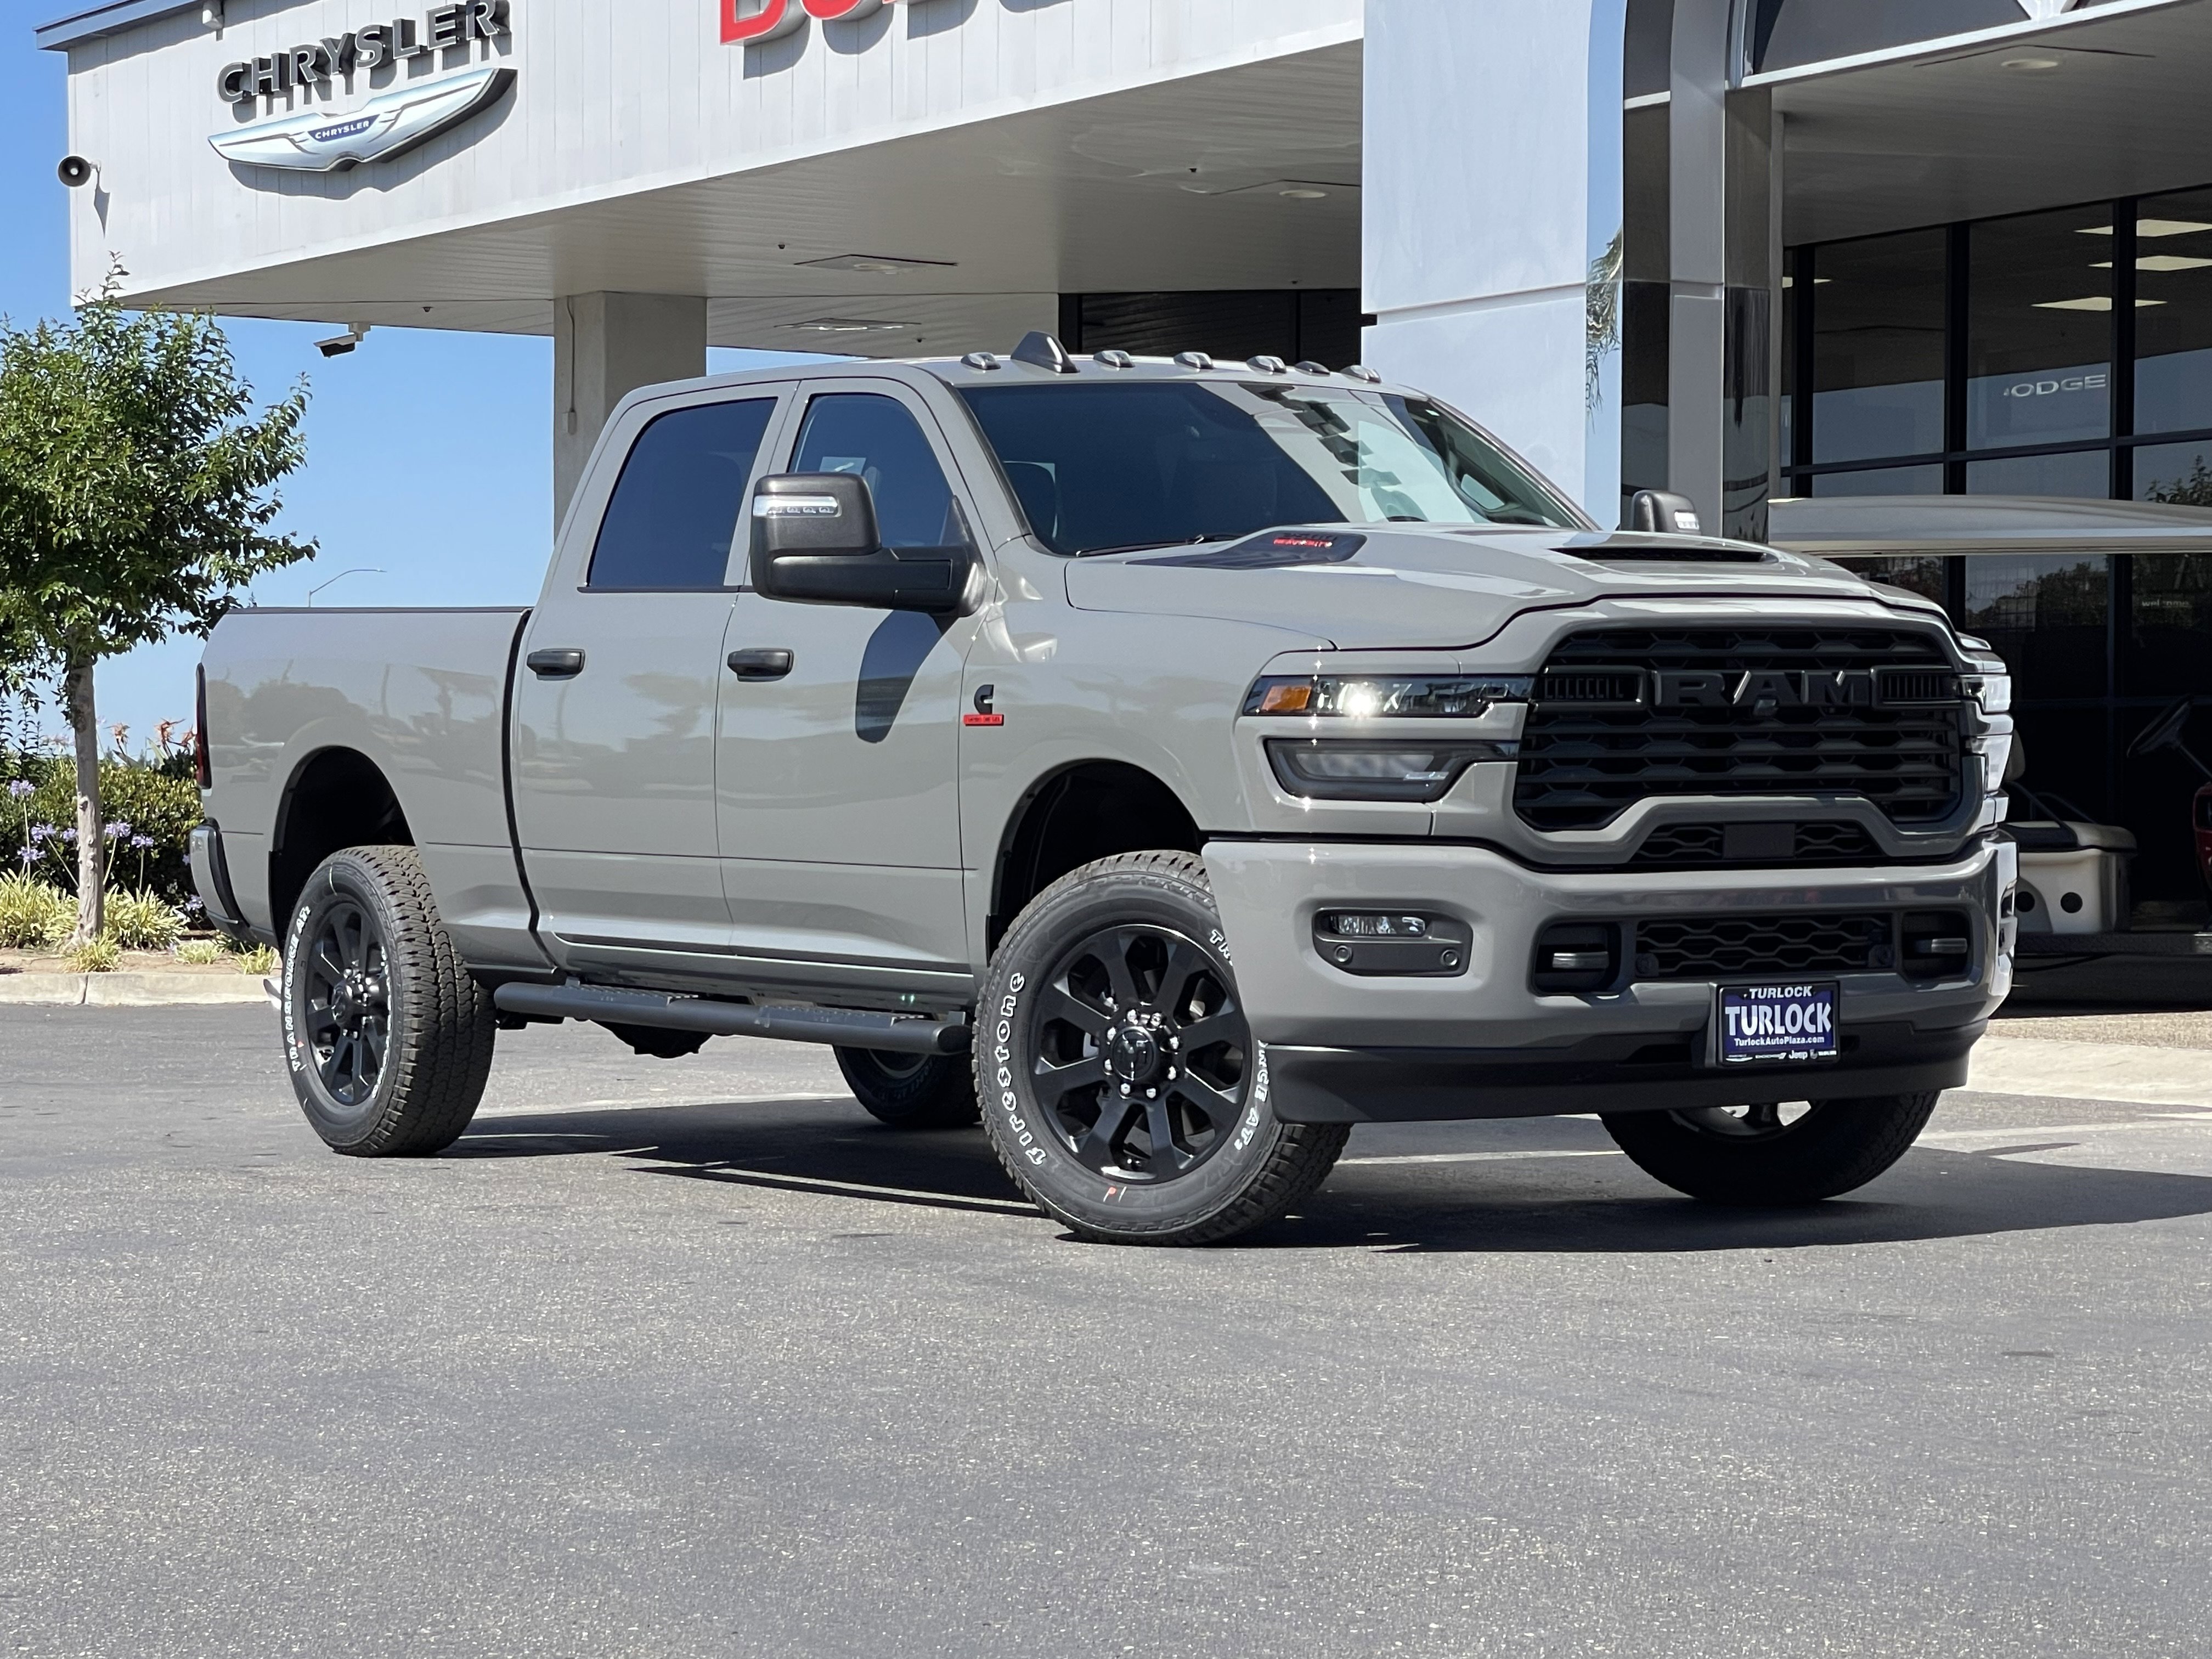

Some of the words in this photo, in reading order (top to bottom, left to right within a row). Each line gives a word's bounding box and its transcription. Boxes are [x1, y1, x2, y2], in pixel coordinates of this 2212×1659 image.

[218, 1, 498, 104] CHRYSLER
[315, 121, 369, 139] CHRYSLER
[2004, 374, 2106, 397] ODGE
[1651, 669, 1871, 706] RAM
[1750, 986, 1813, 999] TURLOCK
[1725, 1002, 1831, 1036] TURLOCK
[1734, 1036, 1825, 1046] TurlockAutoPlaza.com
[995, 973, 1046, 1165] Firestone
